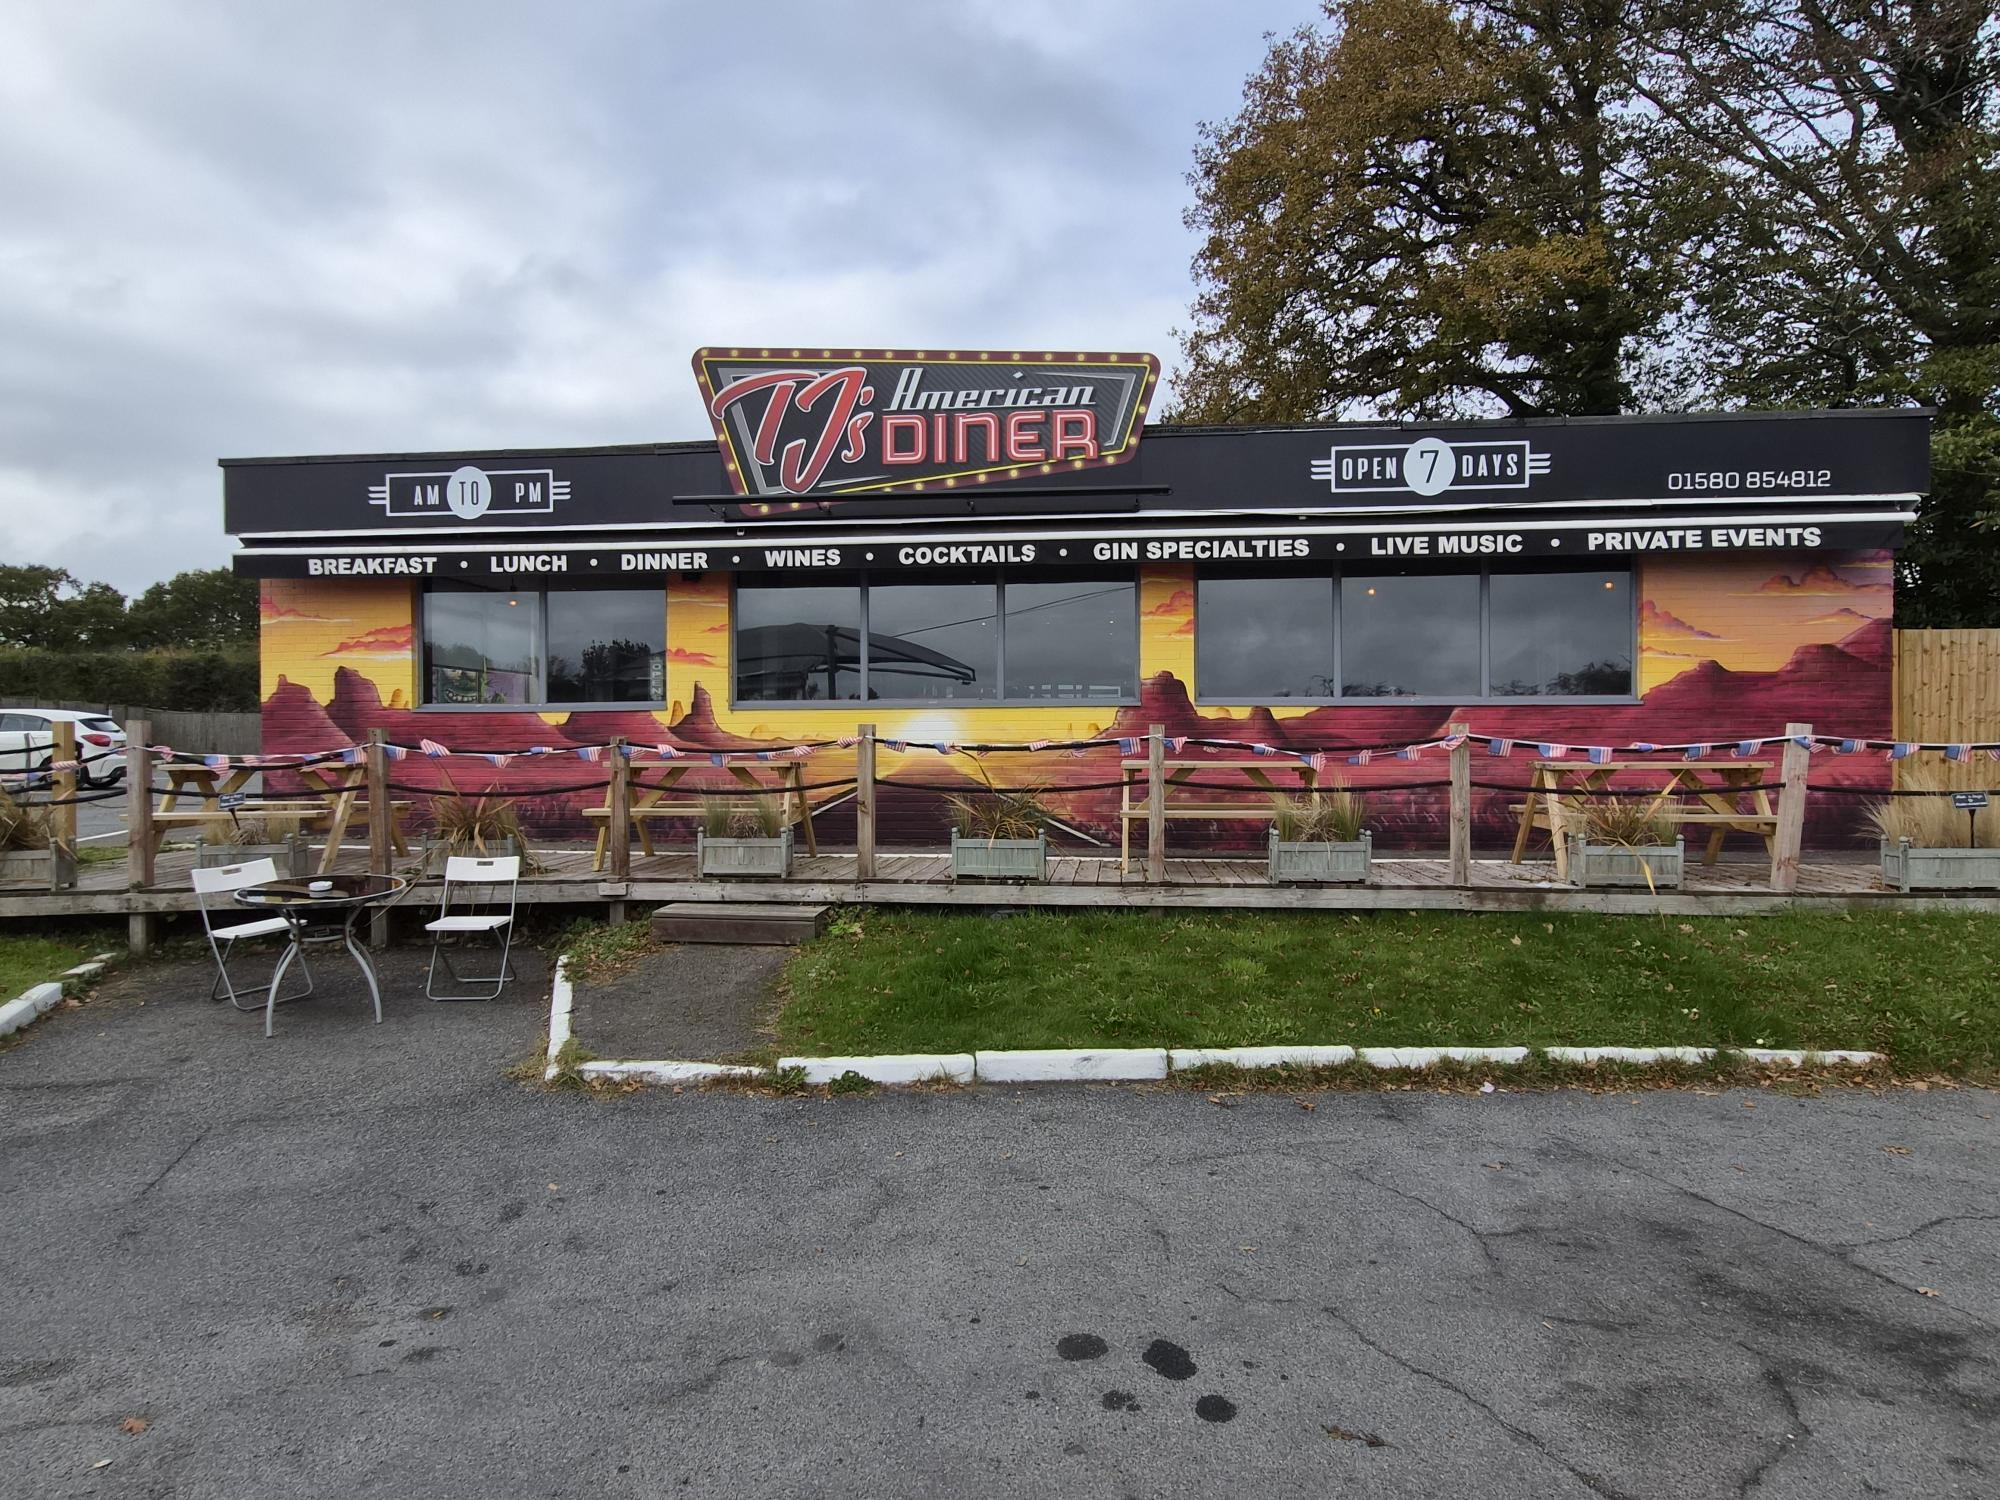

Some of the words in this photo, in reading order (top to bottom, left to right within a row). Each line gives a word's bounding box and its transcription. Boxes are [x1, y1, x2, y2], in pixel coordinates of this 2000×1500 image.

[882, 367, 1097, 411] American
[711, 366, 874, 495] TJ's
[882, 408, 1098, 465] DINER
[1341, 456, 1397, 480] OPEN
[1418, 449, 1440, 484] 7
[1461, 453, 1519, 477] DAYS
[1668, 471, 1740, 490] 01580
[1746, 470, 1831, 489] 854812
[413, 484, 440, 505] AM
[458, 480, 479, 506] TO
[515, 482, 542, 503] PM
[308, 556, 437, 575] BREAKFAST
[490, 554, 567, 573] LUNCH
[621, 551, 708, 571] DINNER
[765, 548, 841, 567] WINES
[898, 544, 1036, 565] COCKTAILS
[1093, 541, 1138, 562] GIN
[1146, 538, 1310, 560] SPECIALTIES
[1370, 535, 1430, 556] LIVE
[1438, 534, 1523, 554] MUSIC
[1588, 529, 1703, 551] PRIVATE
[1711, 526, 1822, 548] EVENTS
